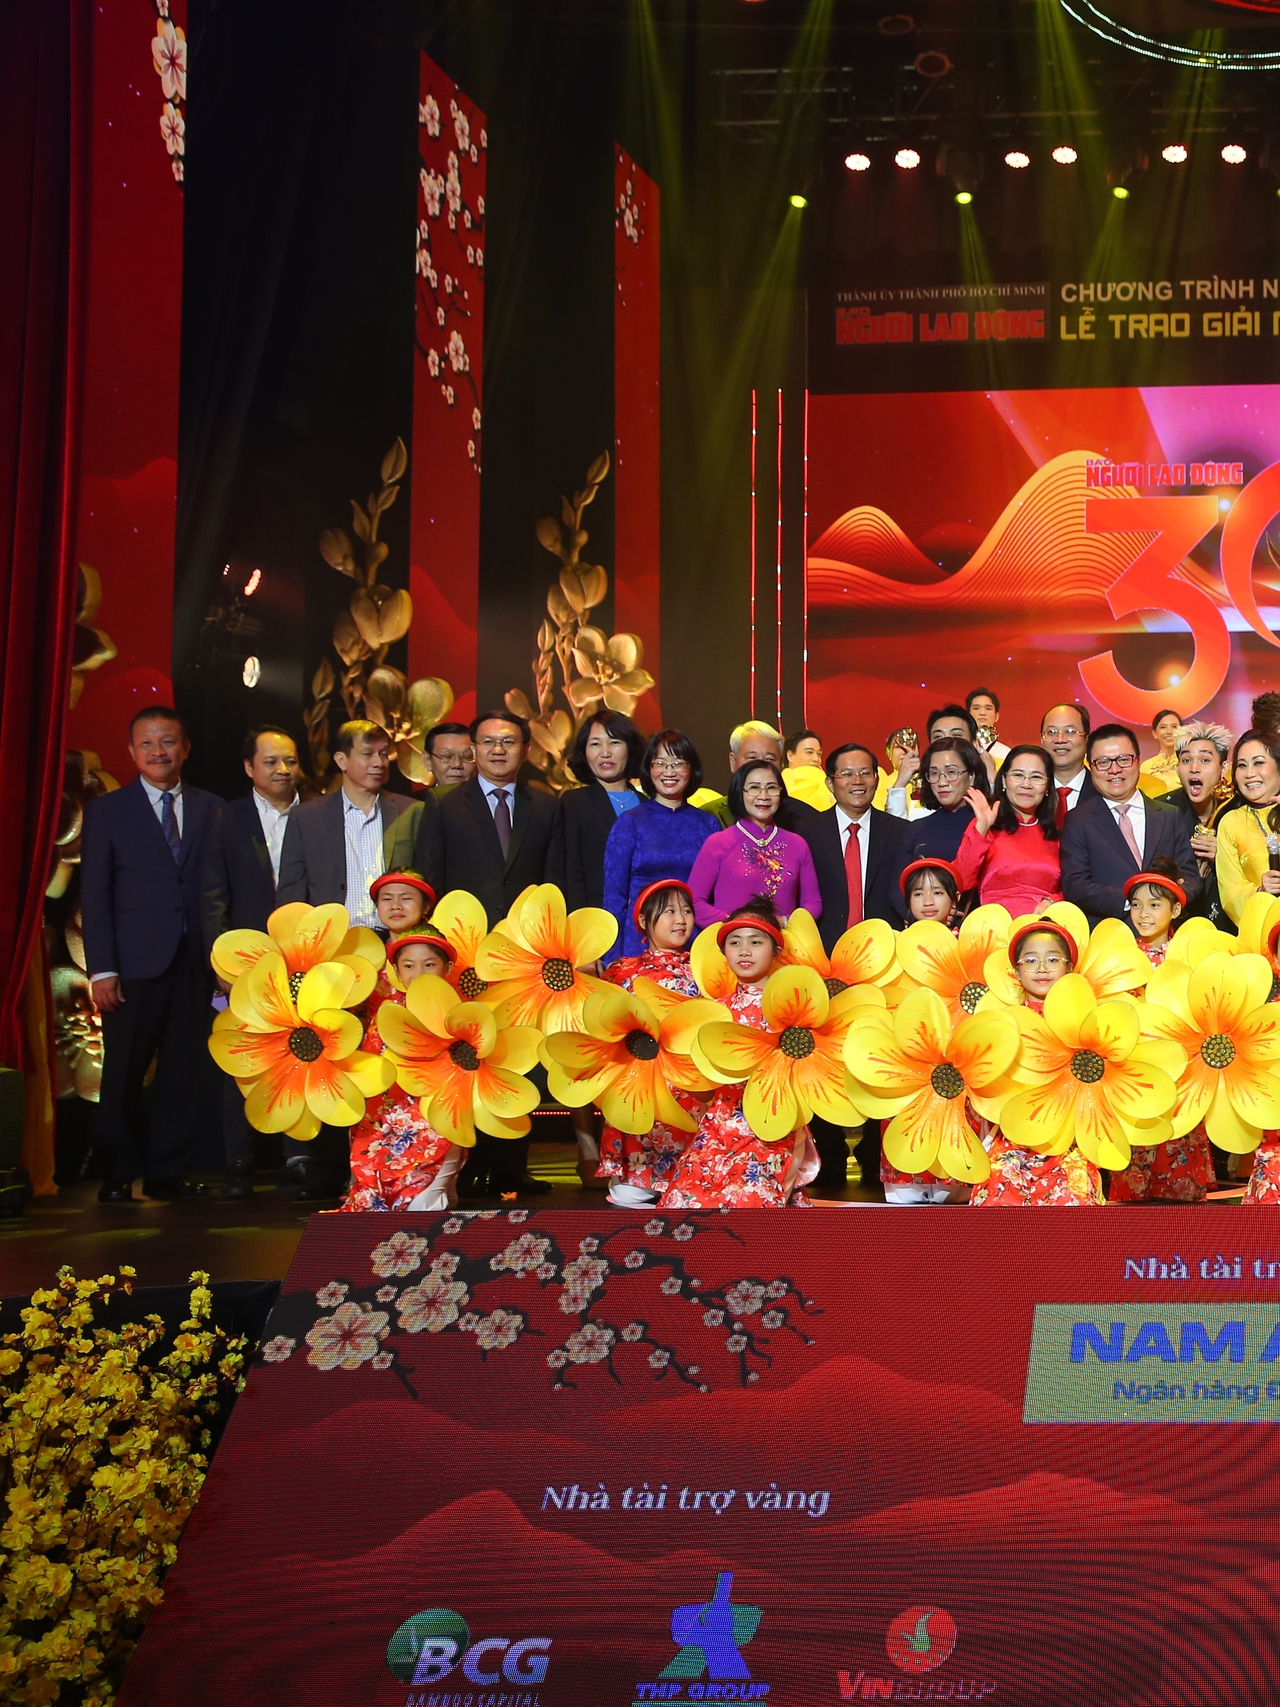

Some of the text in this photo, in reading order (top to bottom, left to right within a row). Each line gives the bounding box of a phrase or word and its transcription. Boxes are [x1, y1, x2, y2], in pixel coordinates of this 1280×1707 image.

[989, 282, 1011, 297] CHÍ
[1013, 285, 1046, 296] MINH
[1061, 279, 1173, 303] CHƯƠNG
[1180, 275, 1254, 300] TRÌNH
[919, 312, 969, 342] LAO
[974, 308, 1045, 341] ĐỘNG
[1060, 306, 1096, 341] LỄ
[1108, 313, 1191, 339] TRAO
[1202, 305, 1260, 337] GIẢI
[1147, 462, 1187, 486] LAO
[1189, 460, 1244, 486] ĐỘNG
[1123, 1255, 1191, 1280] Nhà
[1199, 1255, 1243, 1280] tài
[1069, 1321, 1246, 1363] NAM
[1112, 1379, 1185, 1404] Ngân
[1194, 1379, 1259, 1404] hàng
[540, 1482, 831, 1517] Nhà tài trợ vàng
[410, 1637, 553, 1685] BCG
[635, 1682, 771, 1700] THP GROUP
